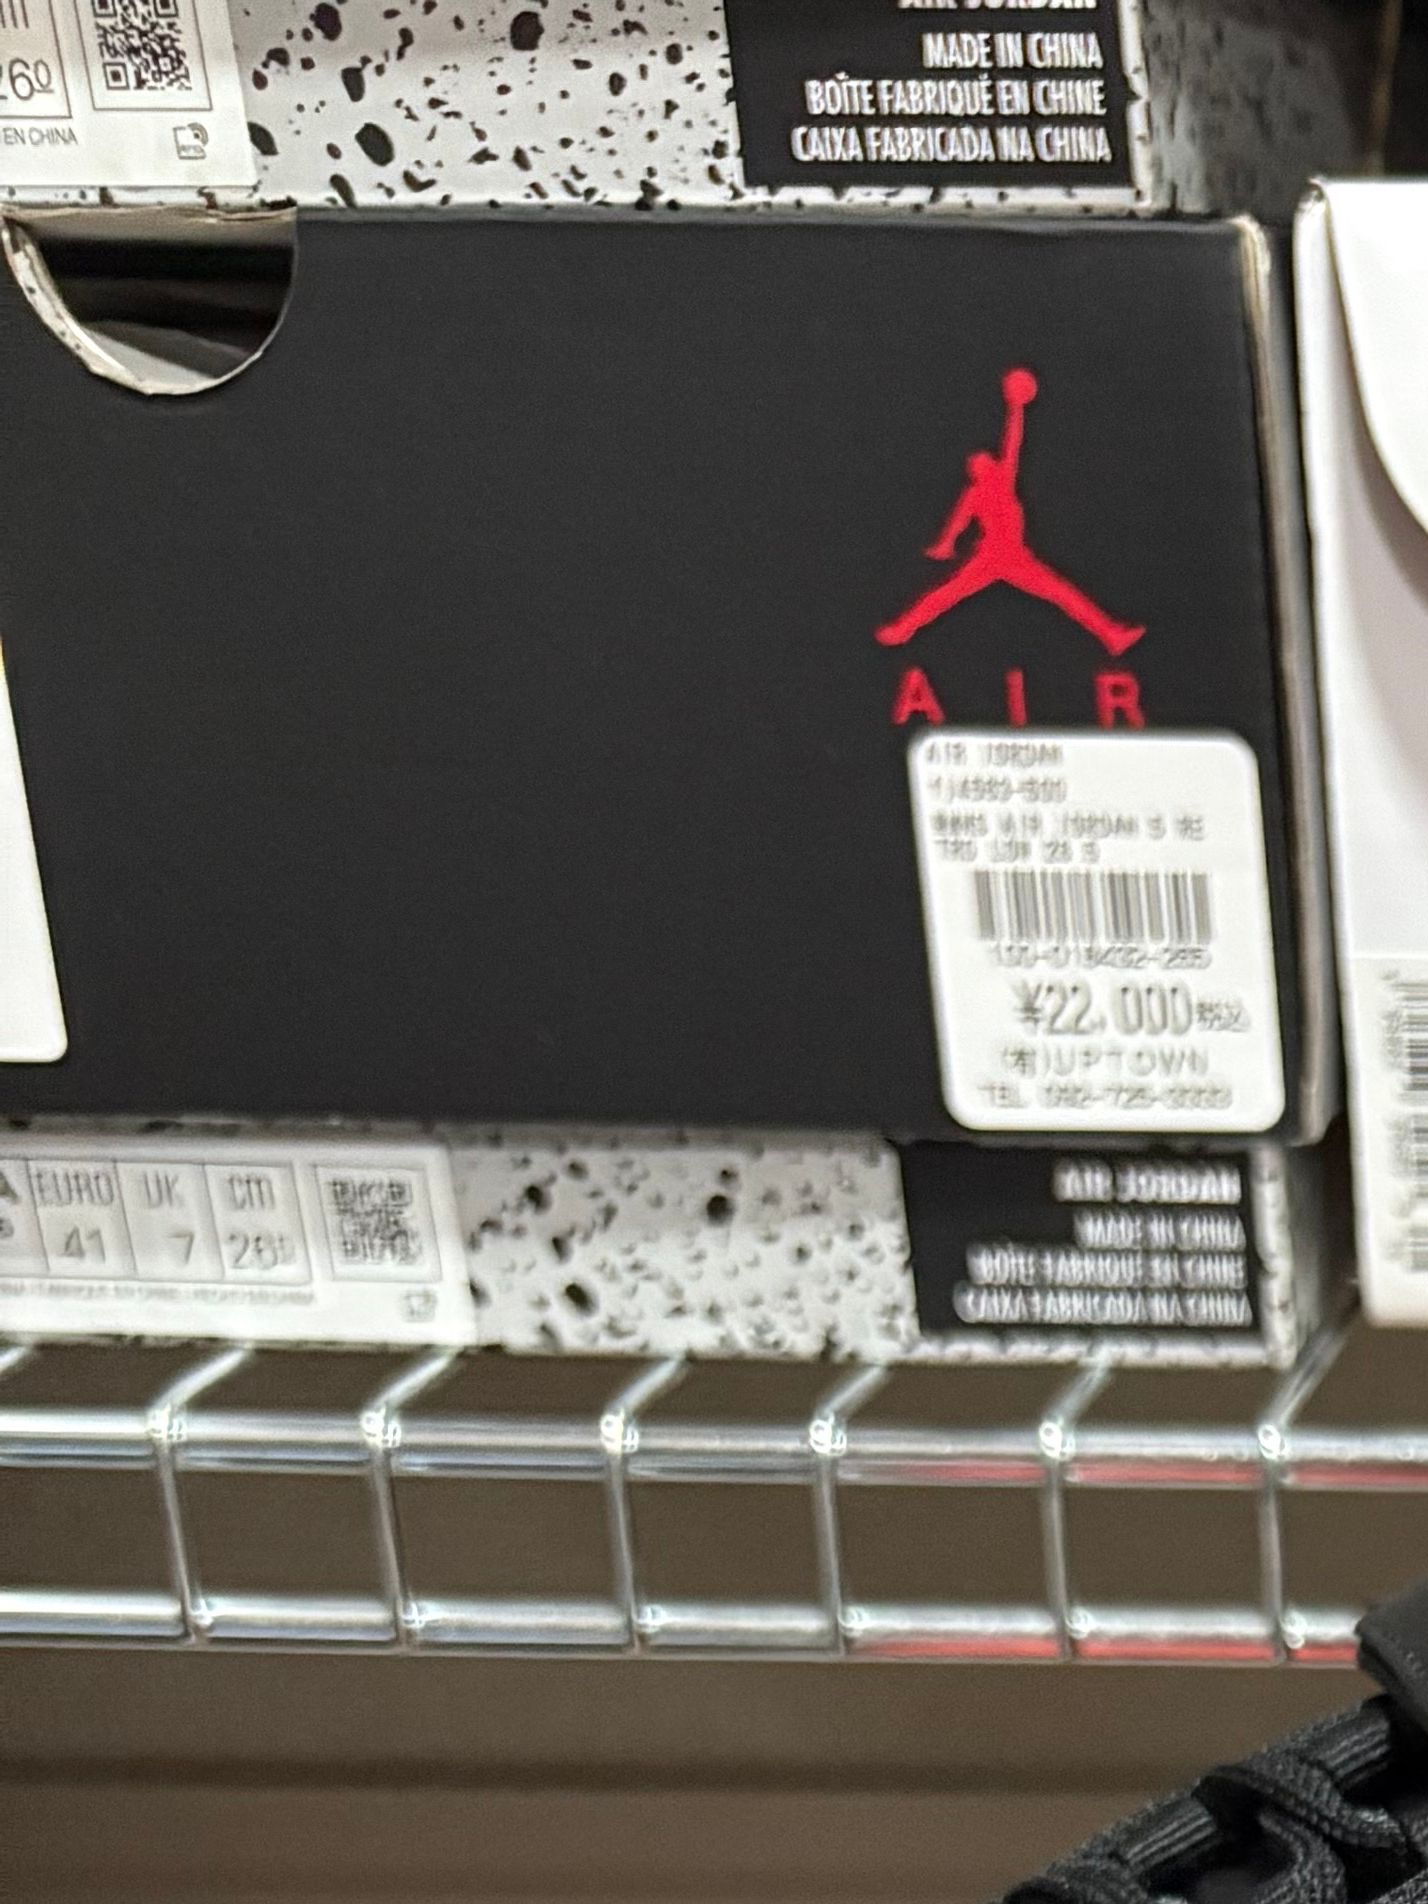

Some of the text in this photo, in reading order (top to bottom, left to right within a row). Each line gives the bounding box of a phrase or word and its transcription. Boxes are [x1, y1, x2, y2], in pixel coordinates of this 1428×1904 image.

[922, 33, 1103, 68] MADE IN CHINA
[804, 72, 1108, 117] BOÎTE FABRIQUÉ EN CHINE
[3, 127, 79, 147] EN CHINA
[790, 126, 1113, 163] CAIXA FABRICADA NA CHINA
[892, 668, 1147, 728] AIR
